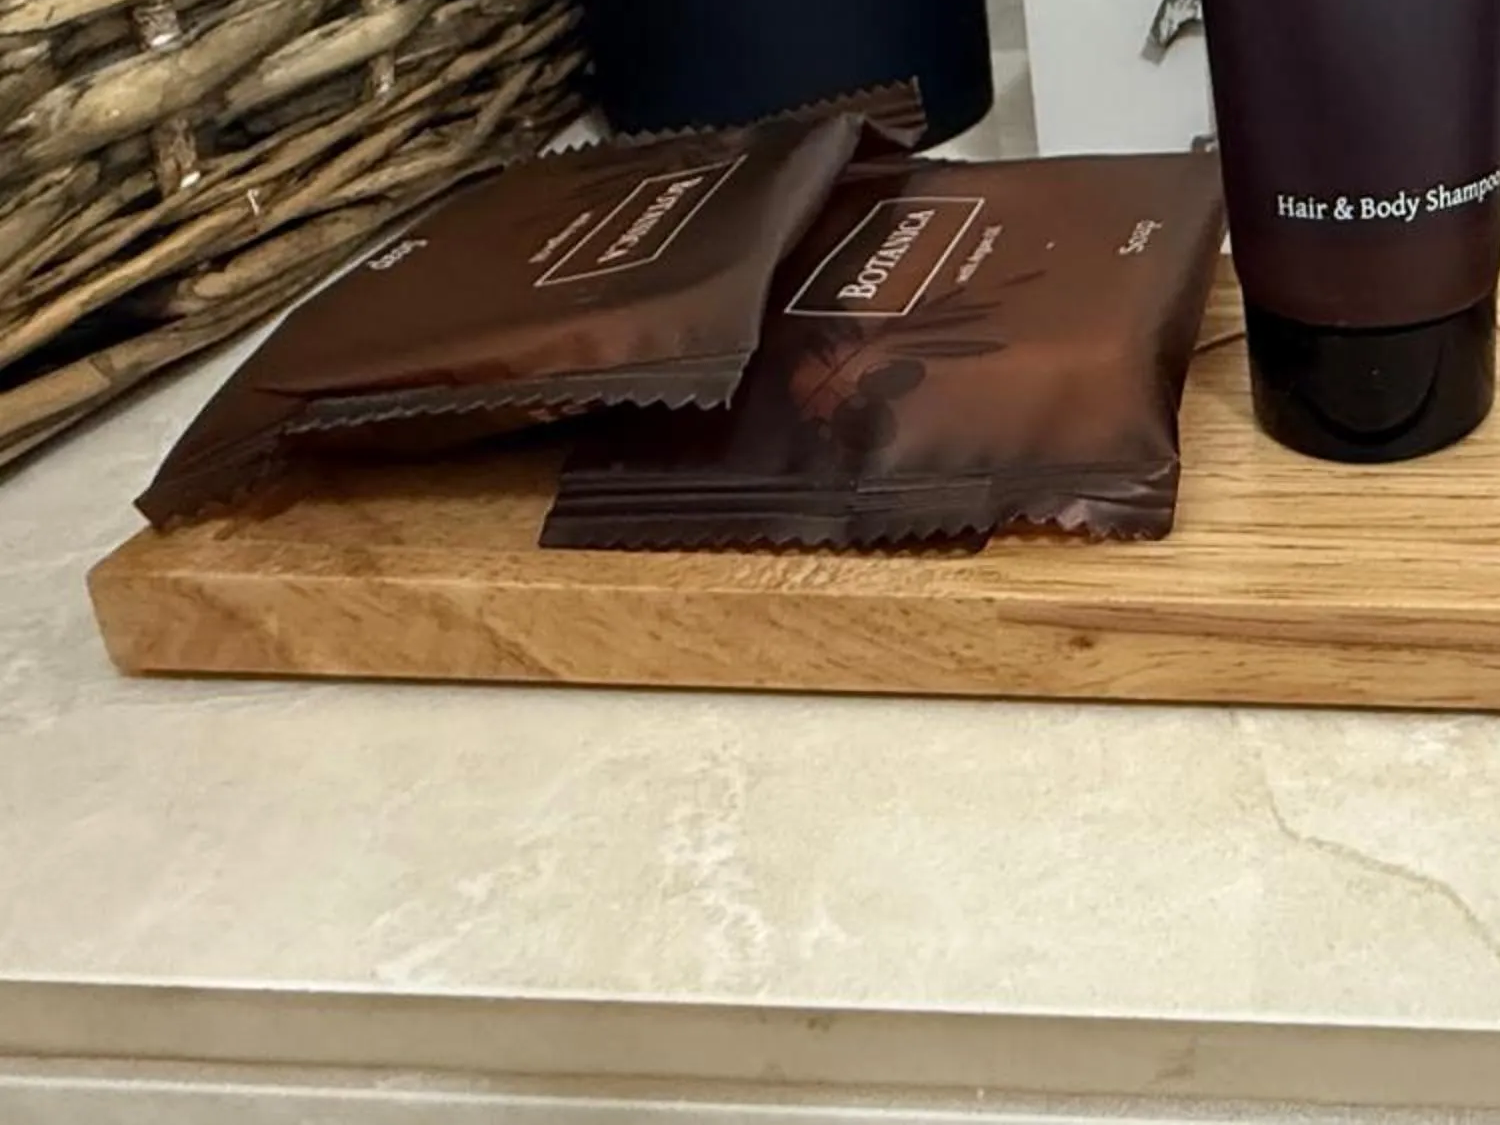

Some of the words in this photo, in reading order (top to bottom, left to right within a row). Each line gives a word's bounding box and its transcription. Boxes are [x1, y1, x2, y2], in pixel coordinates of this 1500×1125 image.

[1277, 194, 1328, 219] Hair
[1333, 196, 1353, 220] &
[1360, 190, 1421, 222] Body
[836, 209, 935, 299] BOTANICA
